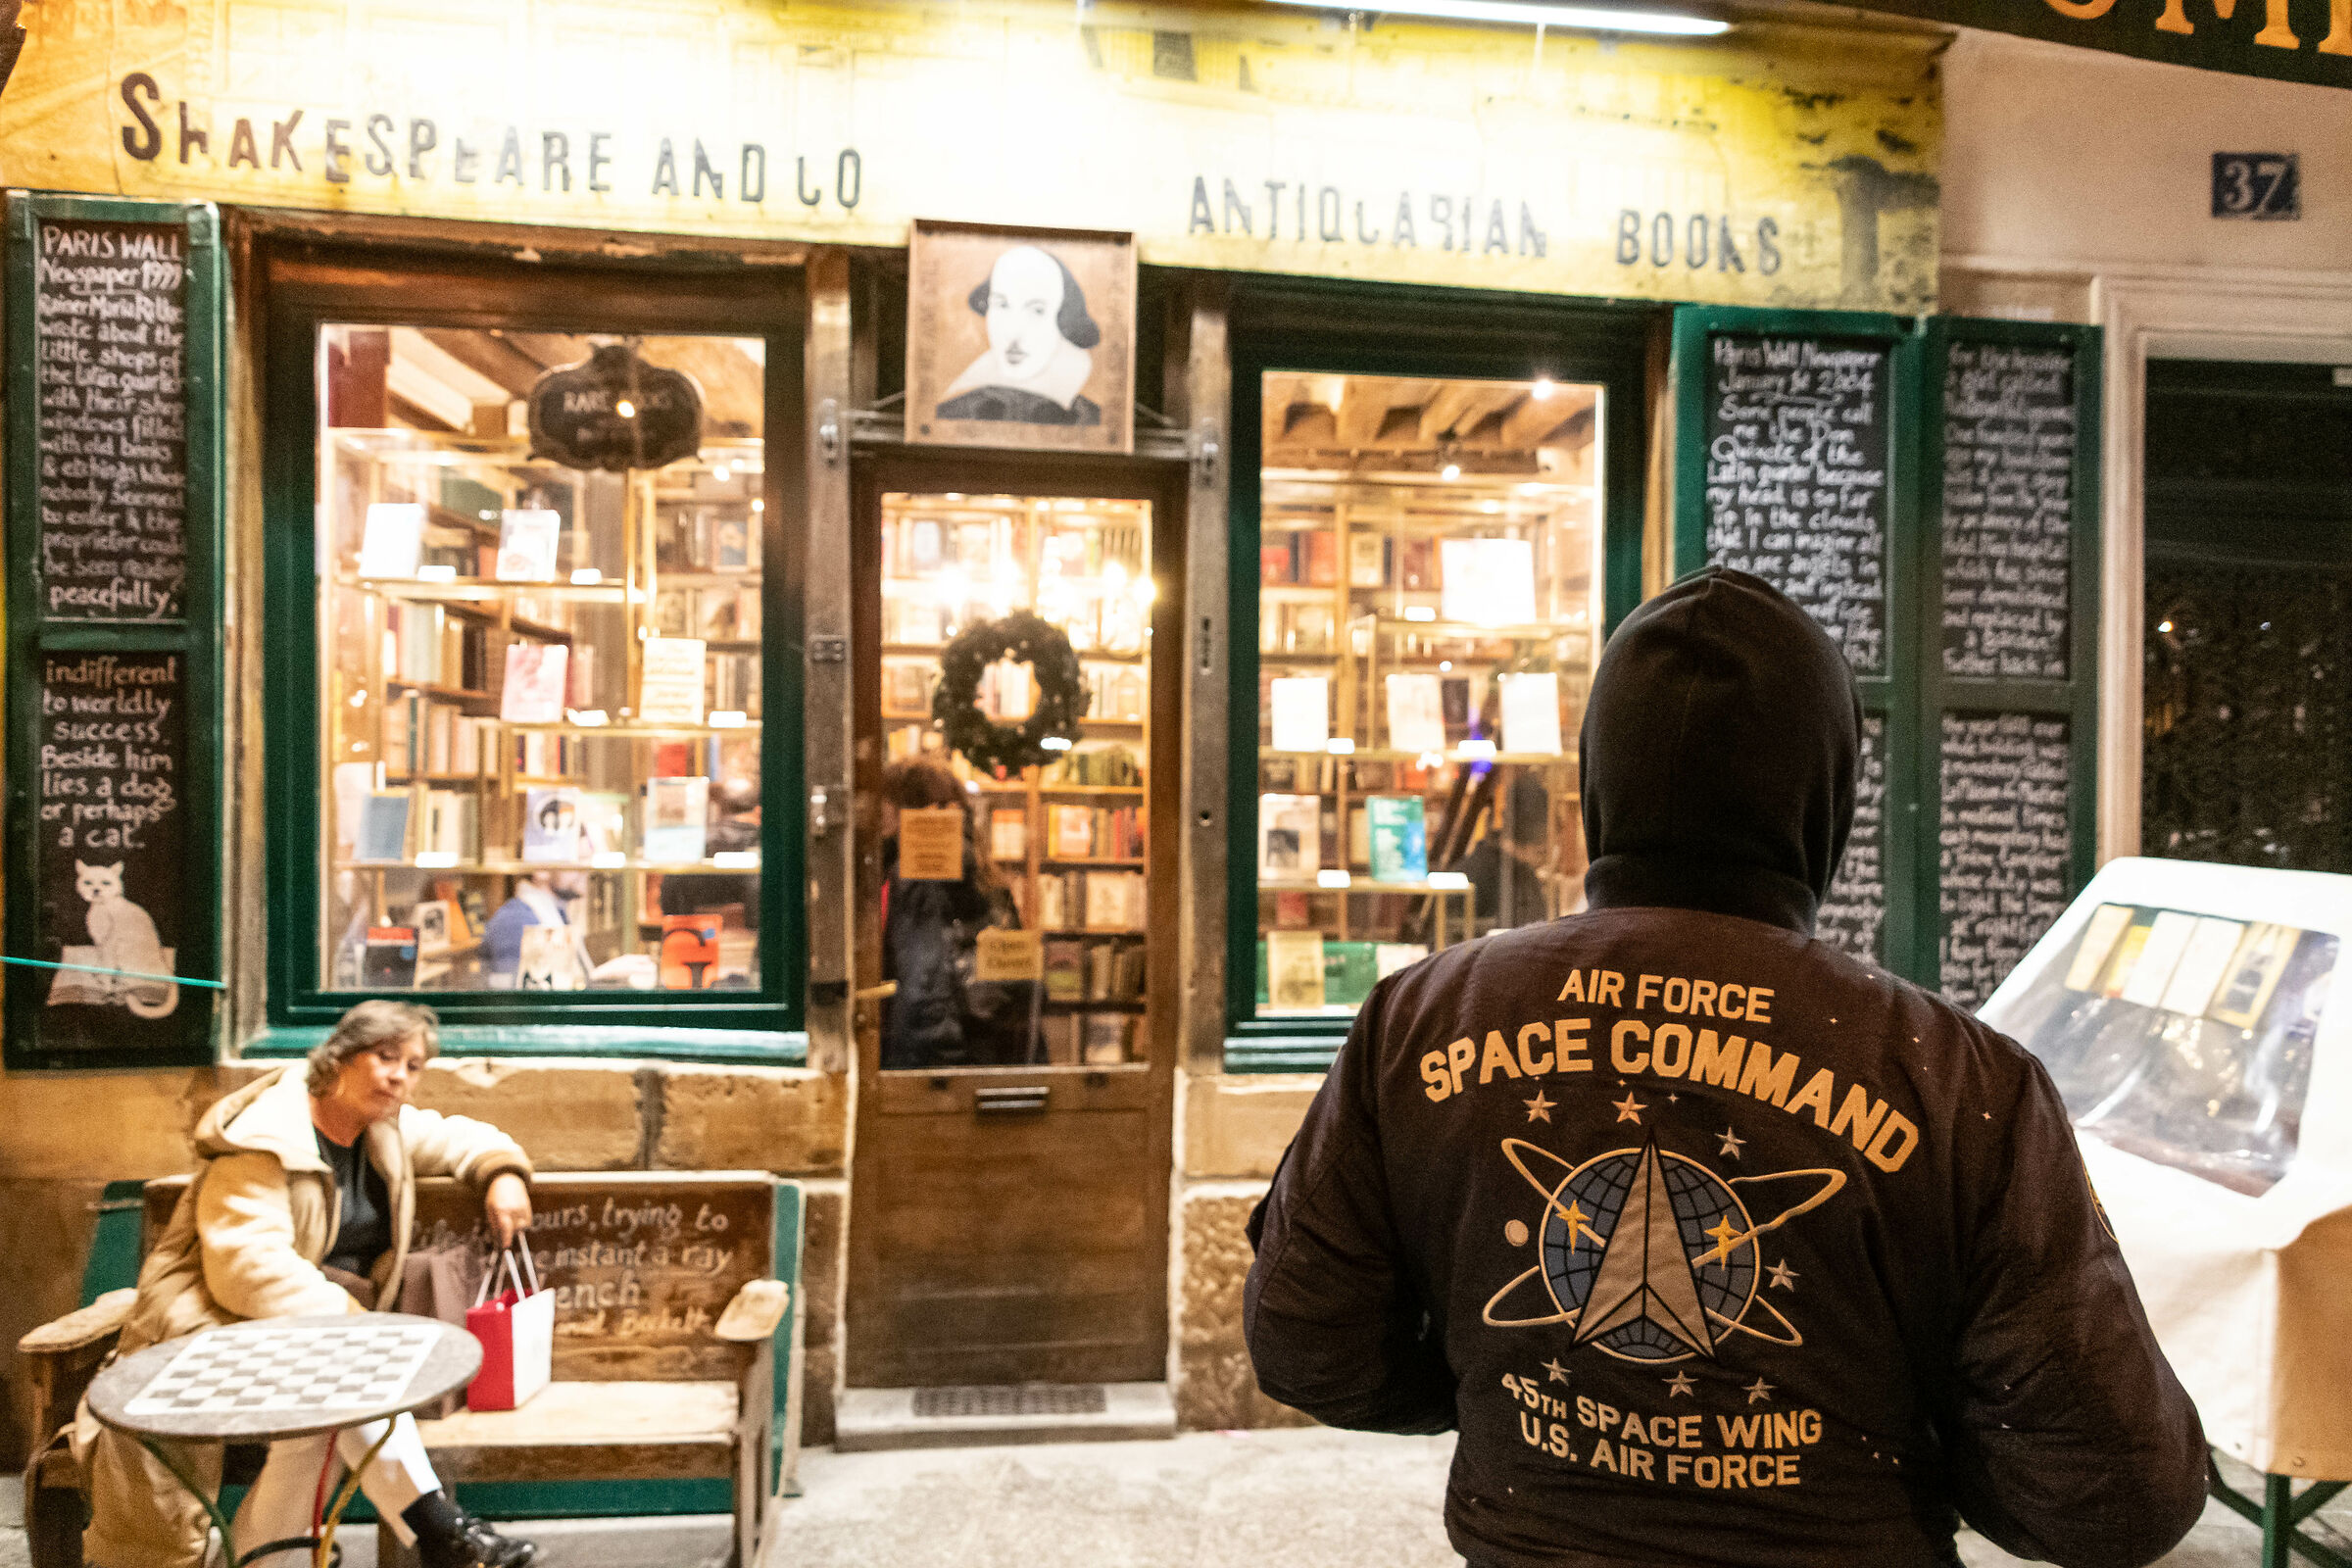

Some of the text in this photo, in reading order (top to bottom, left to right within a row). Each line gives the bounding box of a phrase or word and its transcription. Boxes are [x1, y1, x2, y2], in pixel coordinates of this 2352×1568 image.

[652, 136, 765, 203] AND
[2224, 160, 2291, 217] 37
[43, 225, 180, 262] PARIS WALL
[1615, 208, 1782, 276] BOOKS
[46, 656, 176, 688] indifferent
[42, 688, 68, 715] to
[41, 743, 173, 771] Beside him
[40, 802, 66, 820] or
[42, 771, 177, 812] lies a dog
[58, 826, 74, 848] a
[1557, 968, 1775, 1024] AIR FORCE
[1419, 1017, 1920, 1173] SPACE COMMAND
[602, 1197, 683, 1241] trying
[695, 1202, 729, 1232] to
[653, 1245, 670, 1267] a
[681, 1245, 734, 1276] ray
[1501, 1372, 1823, 1448] 45TH SPACE WING
[1520, 1411, 1801, 1490] U.S. AIR FORCE
